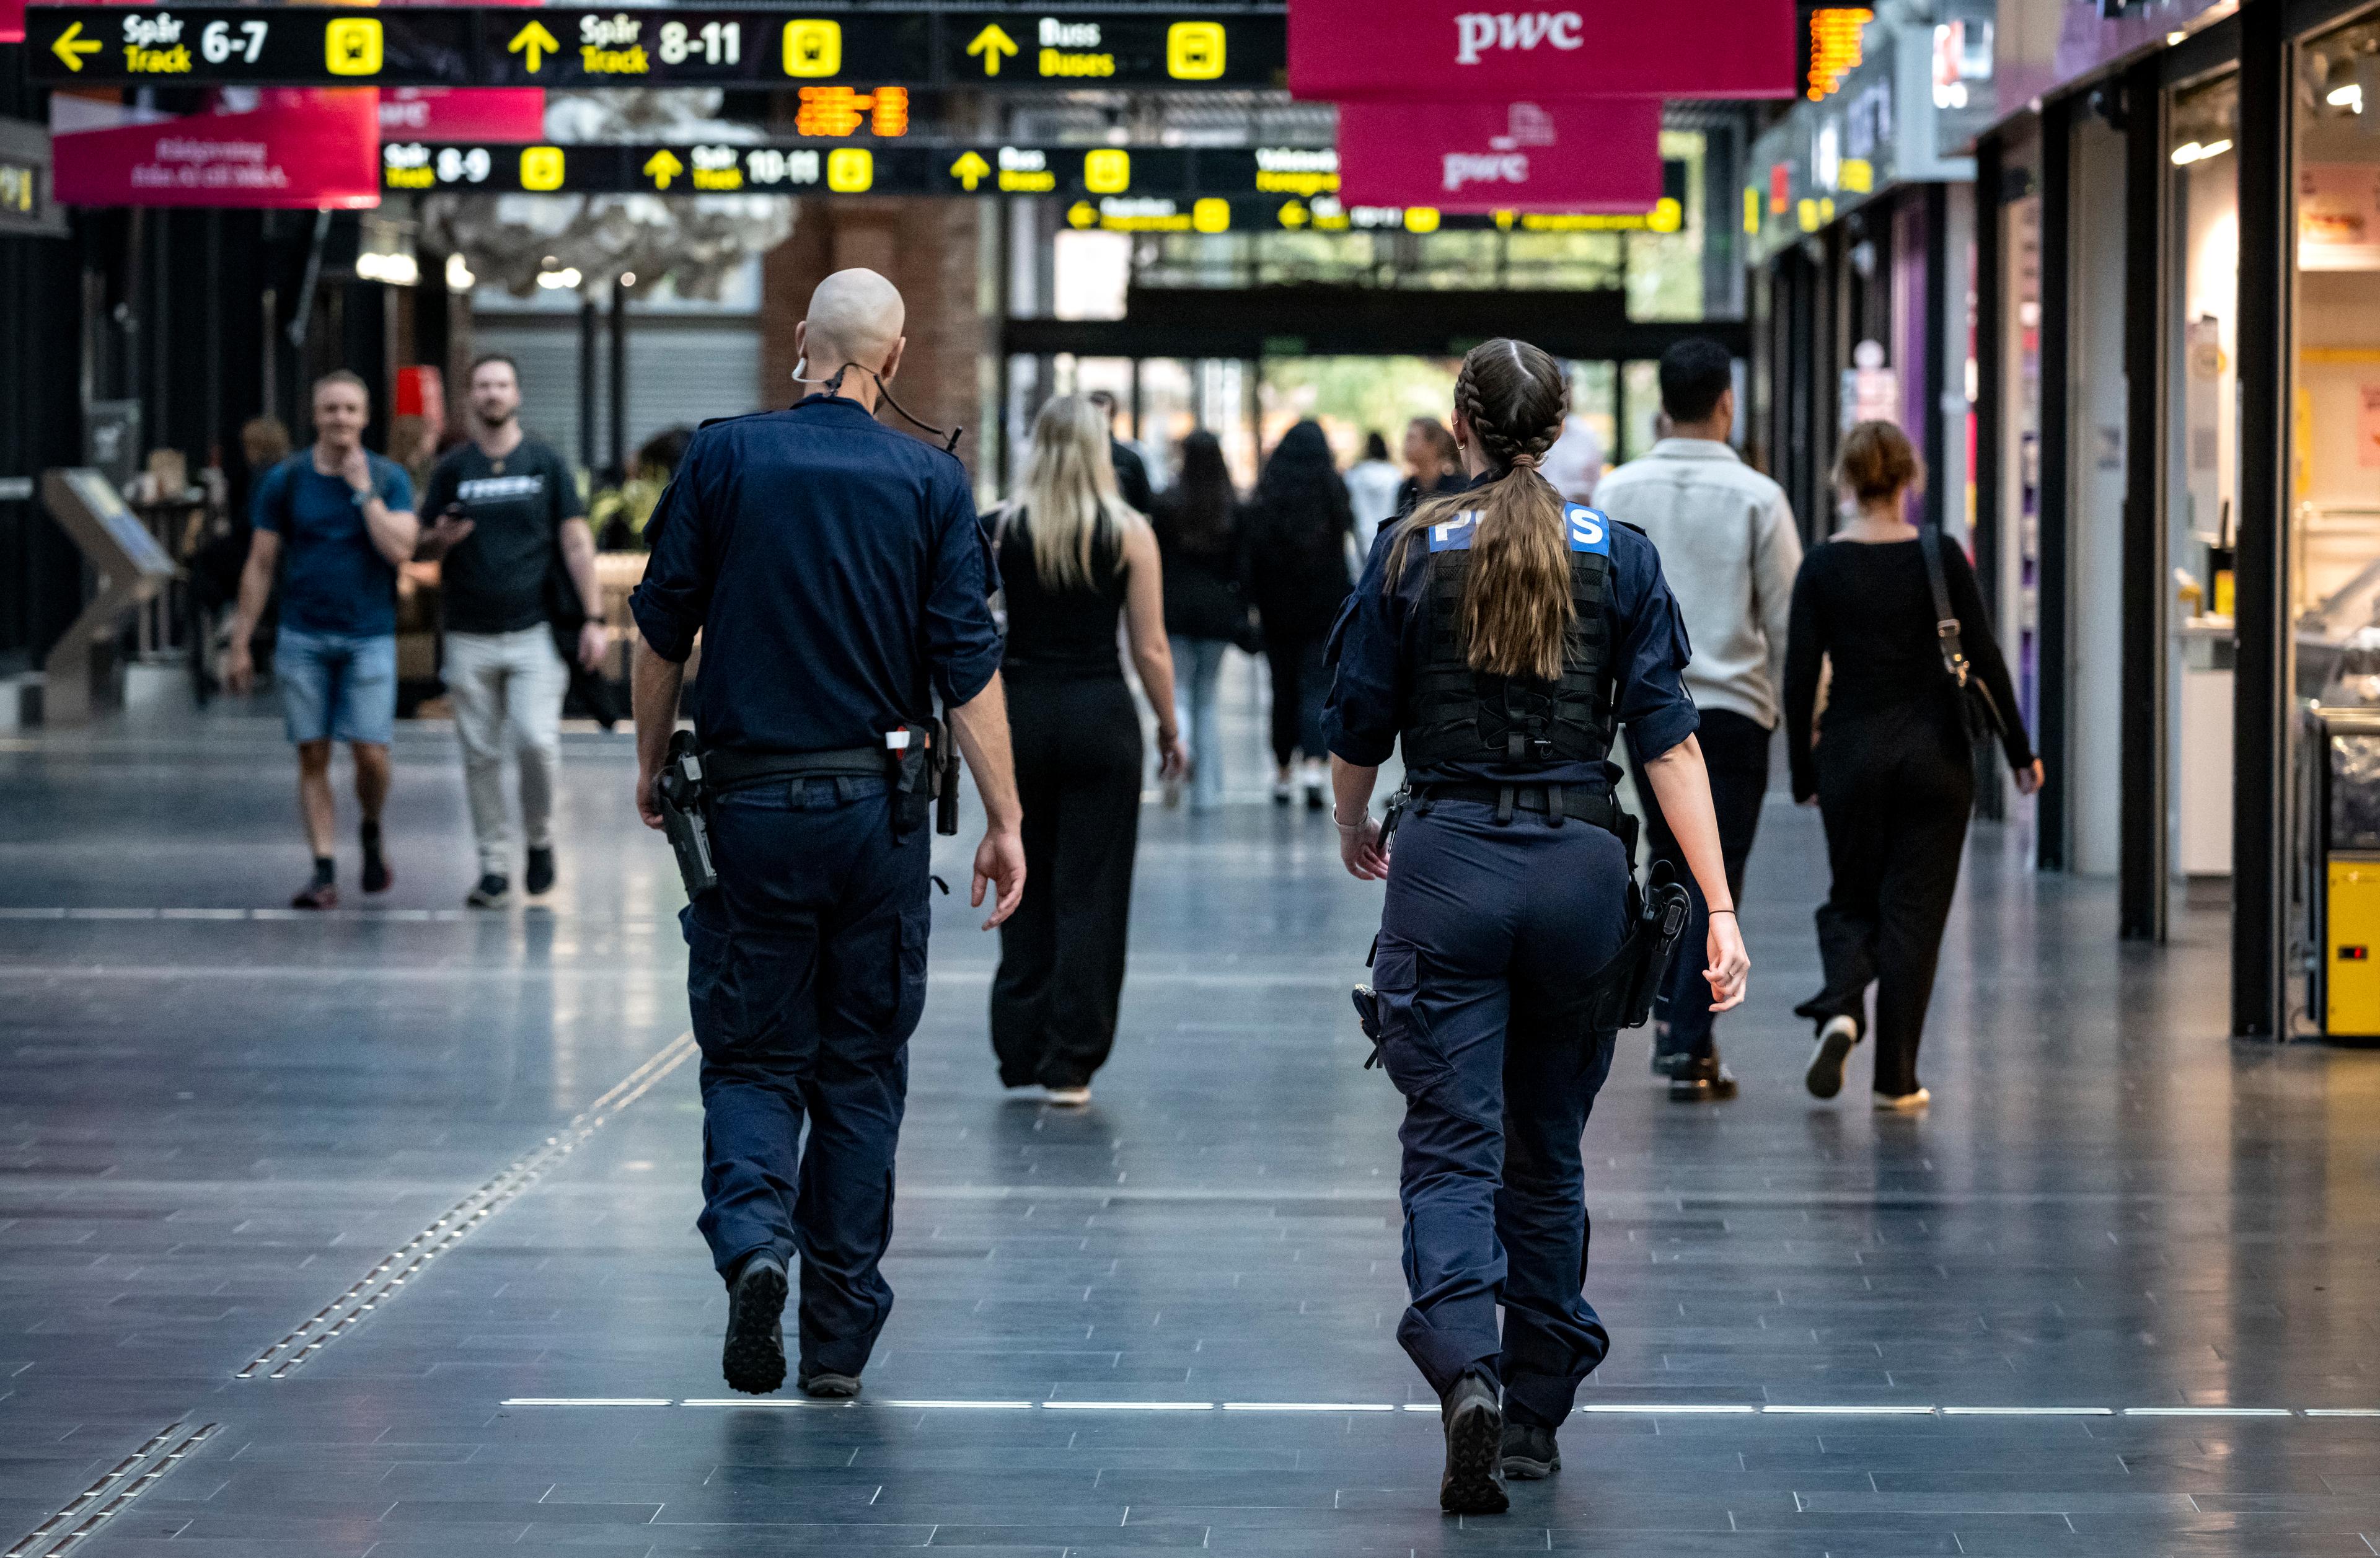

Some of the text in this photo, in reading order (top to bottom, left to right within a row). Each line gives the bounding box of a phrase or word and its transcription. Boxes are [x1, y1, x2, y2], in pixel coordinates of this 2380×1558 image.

[123, 12, 268, 63] Spår 6-7
[580, 14, 740, 64] Spår 8-11
[1039, 17, 1101, 46] Buss
[1455, 11, 1584, 64] pwc
[124, 45, 192, 73] Track
[580, 45, 650, 74] Track
[1039, 48, 1115, 77] Buses
[1442, 152, 1529, 191] pwc
